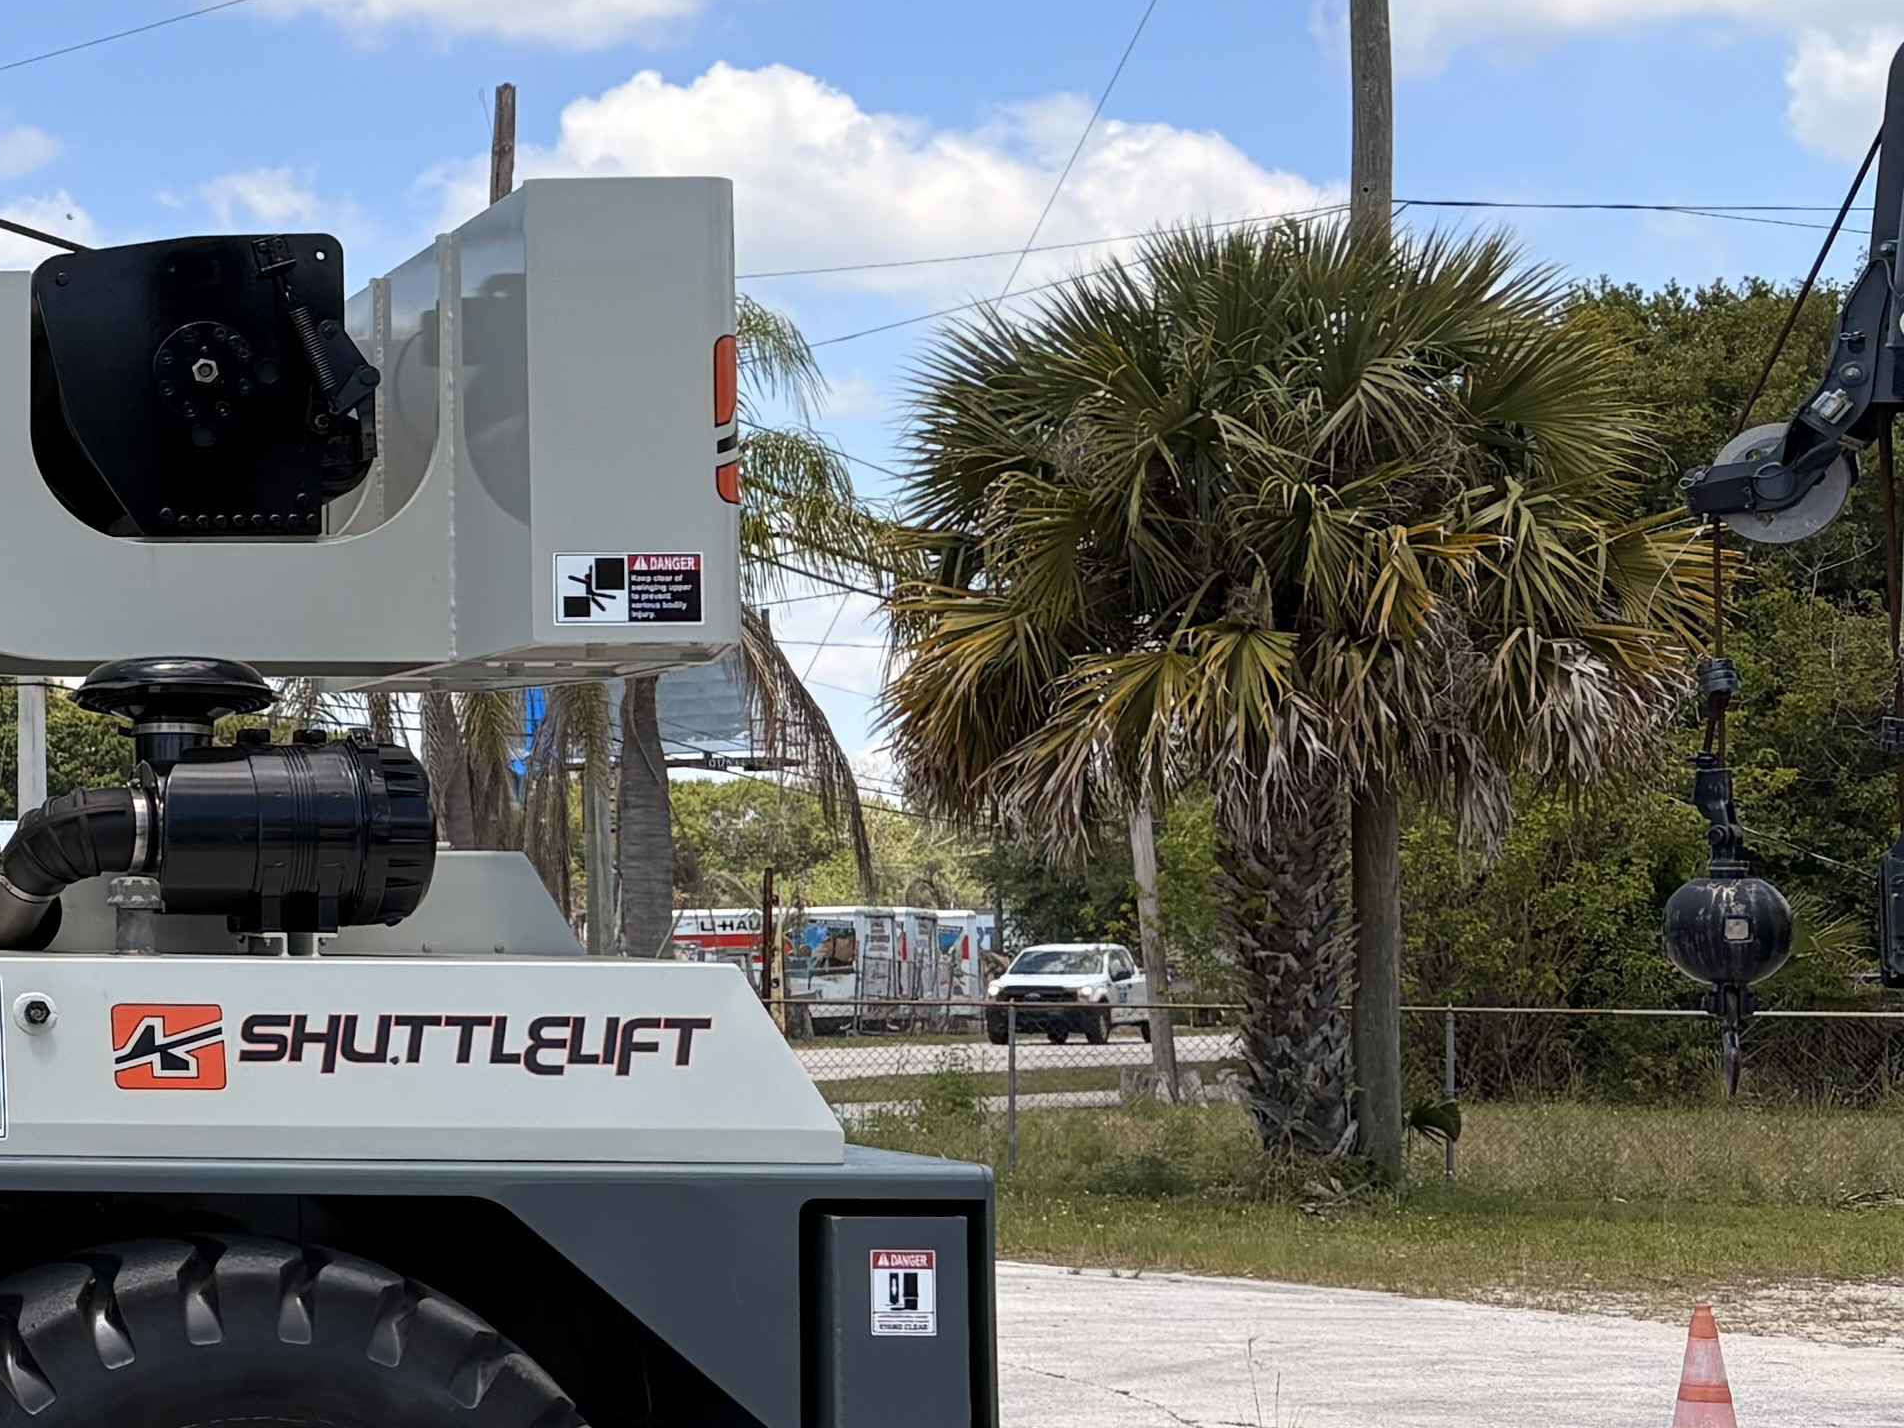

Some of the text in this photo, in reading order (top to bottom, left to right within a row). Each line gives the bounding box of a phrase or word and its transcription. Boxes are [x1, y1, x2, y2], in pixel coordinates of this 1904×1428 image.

[650, 556, 696, 570] DANGER
[238, 1014, 712, 1076] SHUTTLELIFT
[890, 1254, 928, 1267] DANGER
